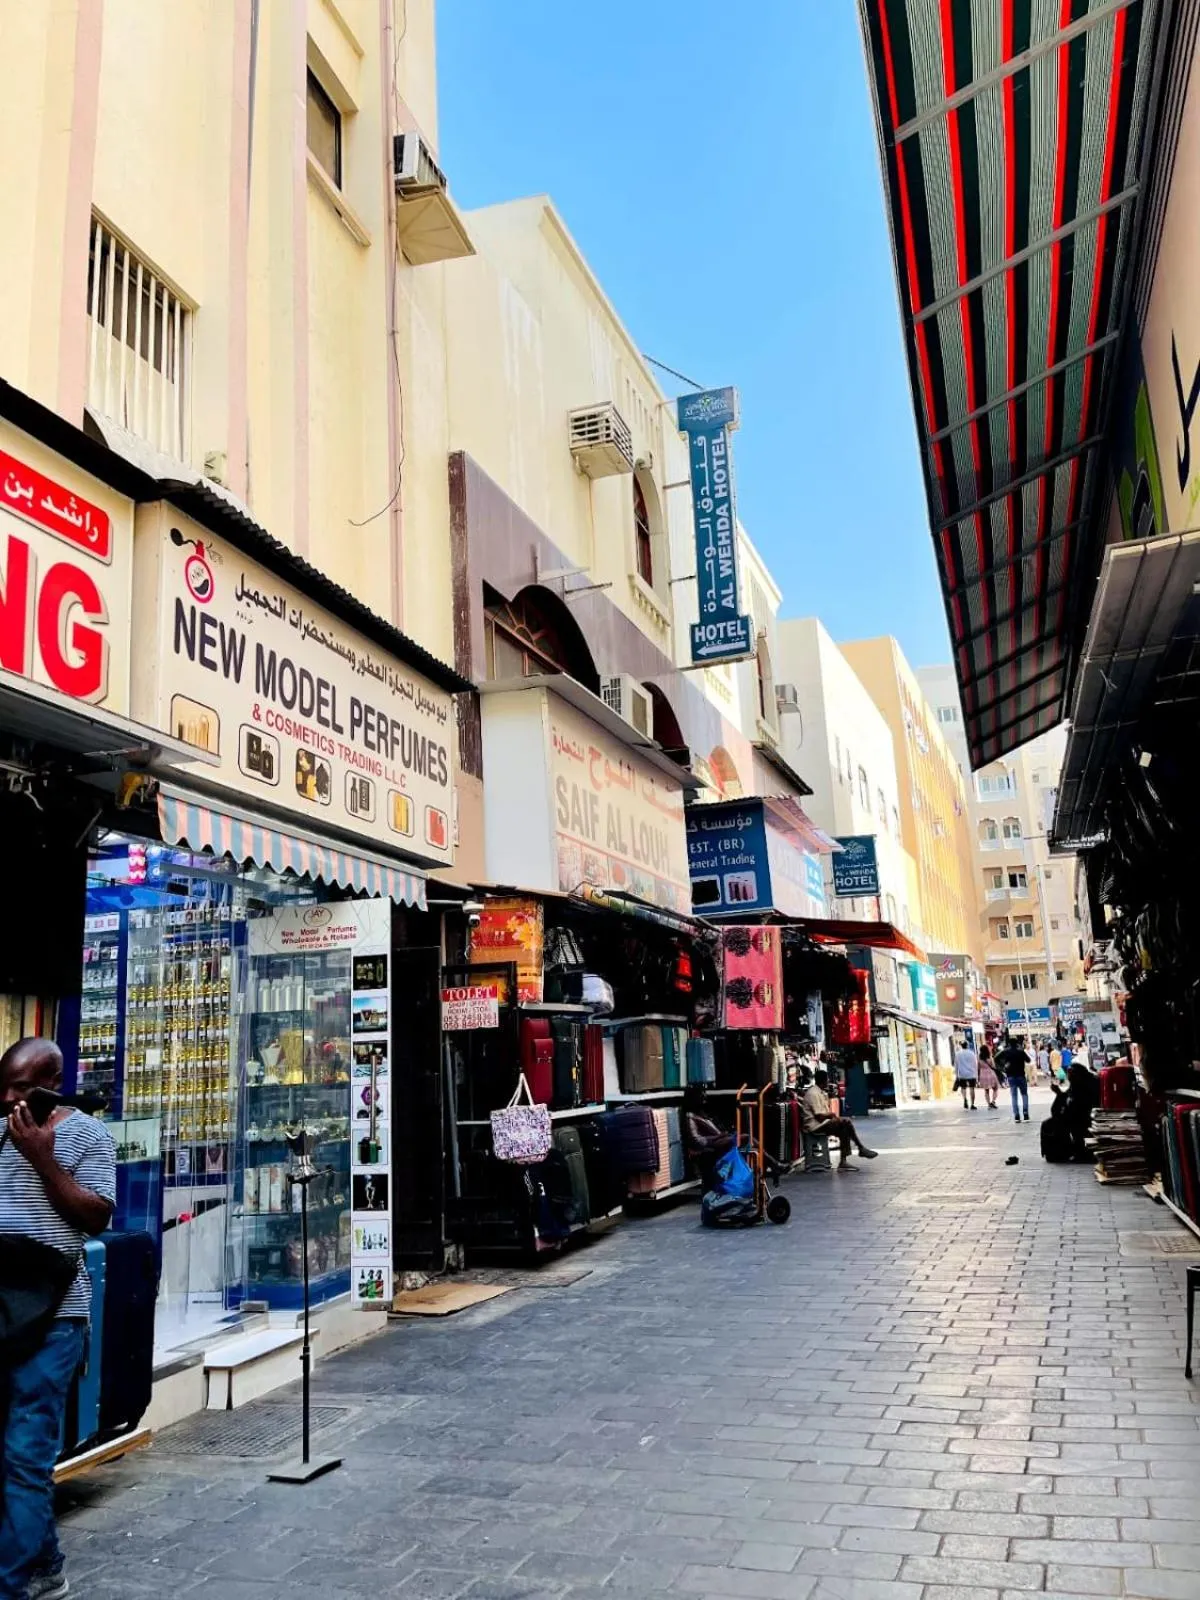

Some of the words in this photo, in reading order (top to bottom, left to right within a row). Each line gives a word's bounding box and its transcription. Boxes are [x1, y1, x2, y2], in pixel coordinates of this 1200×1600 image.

[693, 435, 713, 513] فندق
[711, 431, 728, 499] HOTEL
[4, 471, 34, 508] بن
[40, 495, 99, 542] راشد
[716, 503, 734, 578] WEHDA
[699, 517, 717, 613] الوحدة
[235, 572, 286, 621] التجميل
[721, 582, 735, 609] AL
[695, 620, 747, 643] HOTEL
[173, 596, 247, 685] NEW
[255, 642, 345, 736] MODEL
[349, 695, 448, 788] PERFUMES
[357, 653, 387, 685] العطور
[252, 703, 262, 722] &
[266, 708, 336, 757] COSMETICS
[337, 743, 383, 777] TRADING
[555, 775, 600, 841] SAIF
[606, 802, 628, 856] AL
[701, 813, 753, 831] مؤسسة
[689, 841, 714, 854] EST.
[718, 838, 745, 852] (BR)
[720, 852, 756, 866] Trading
[835, 876, 876, 887] HOTEL
